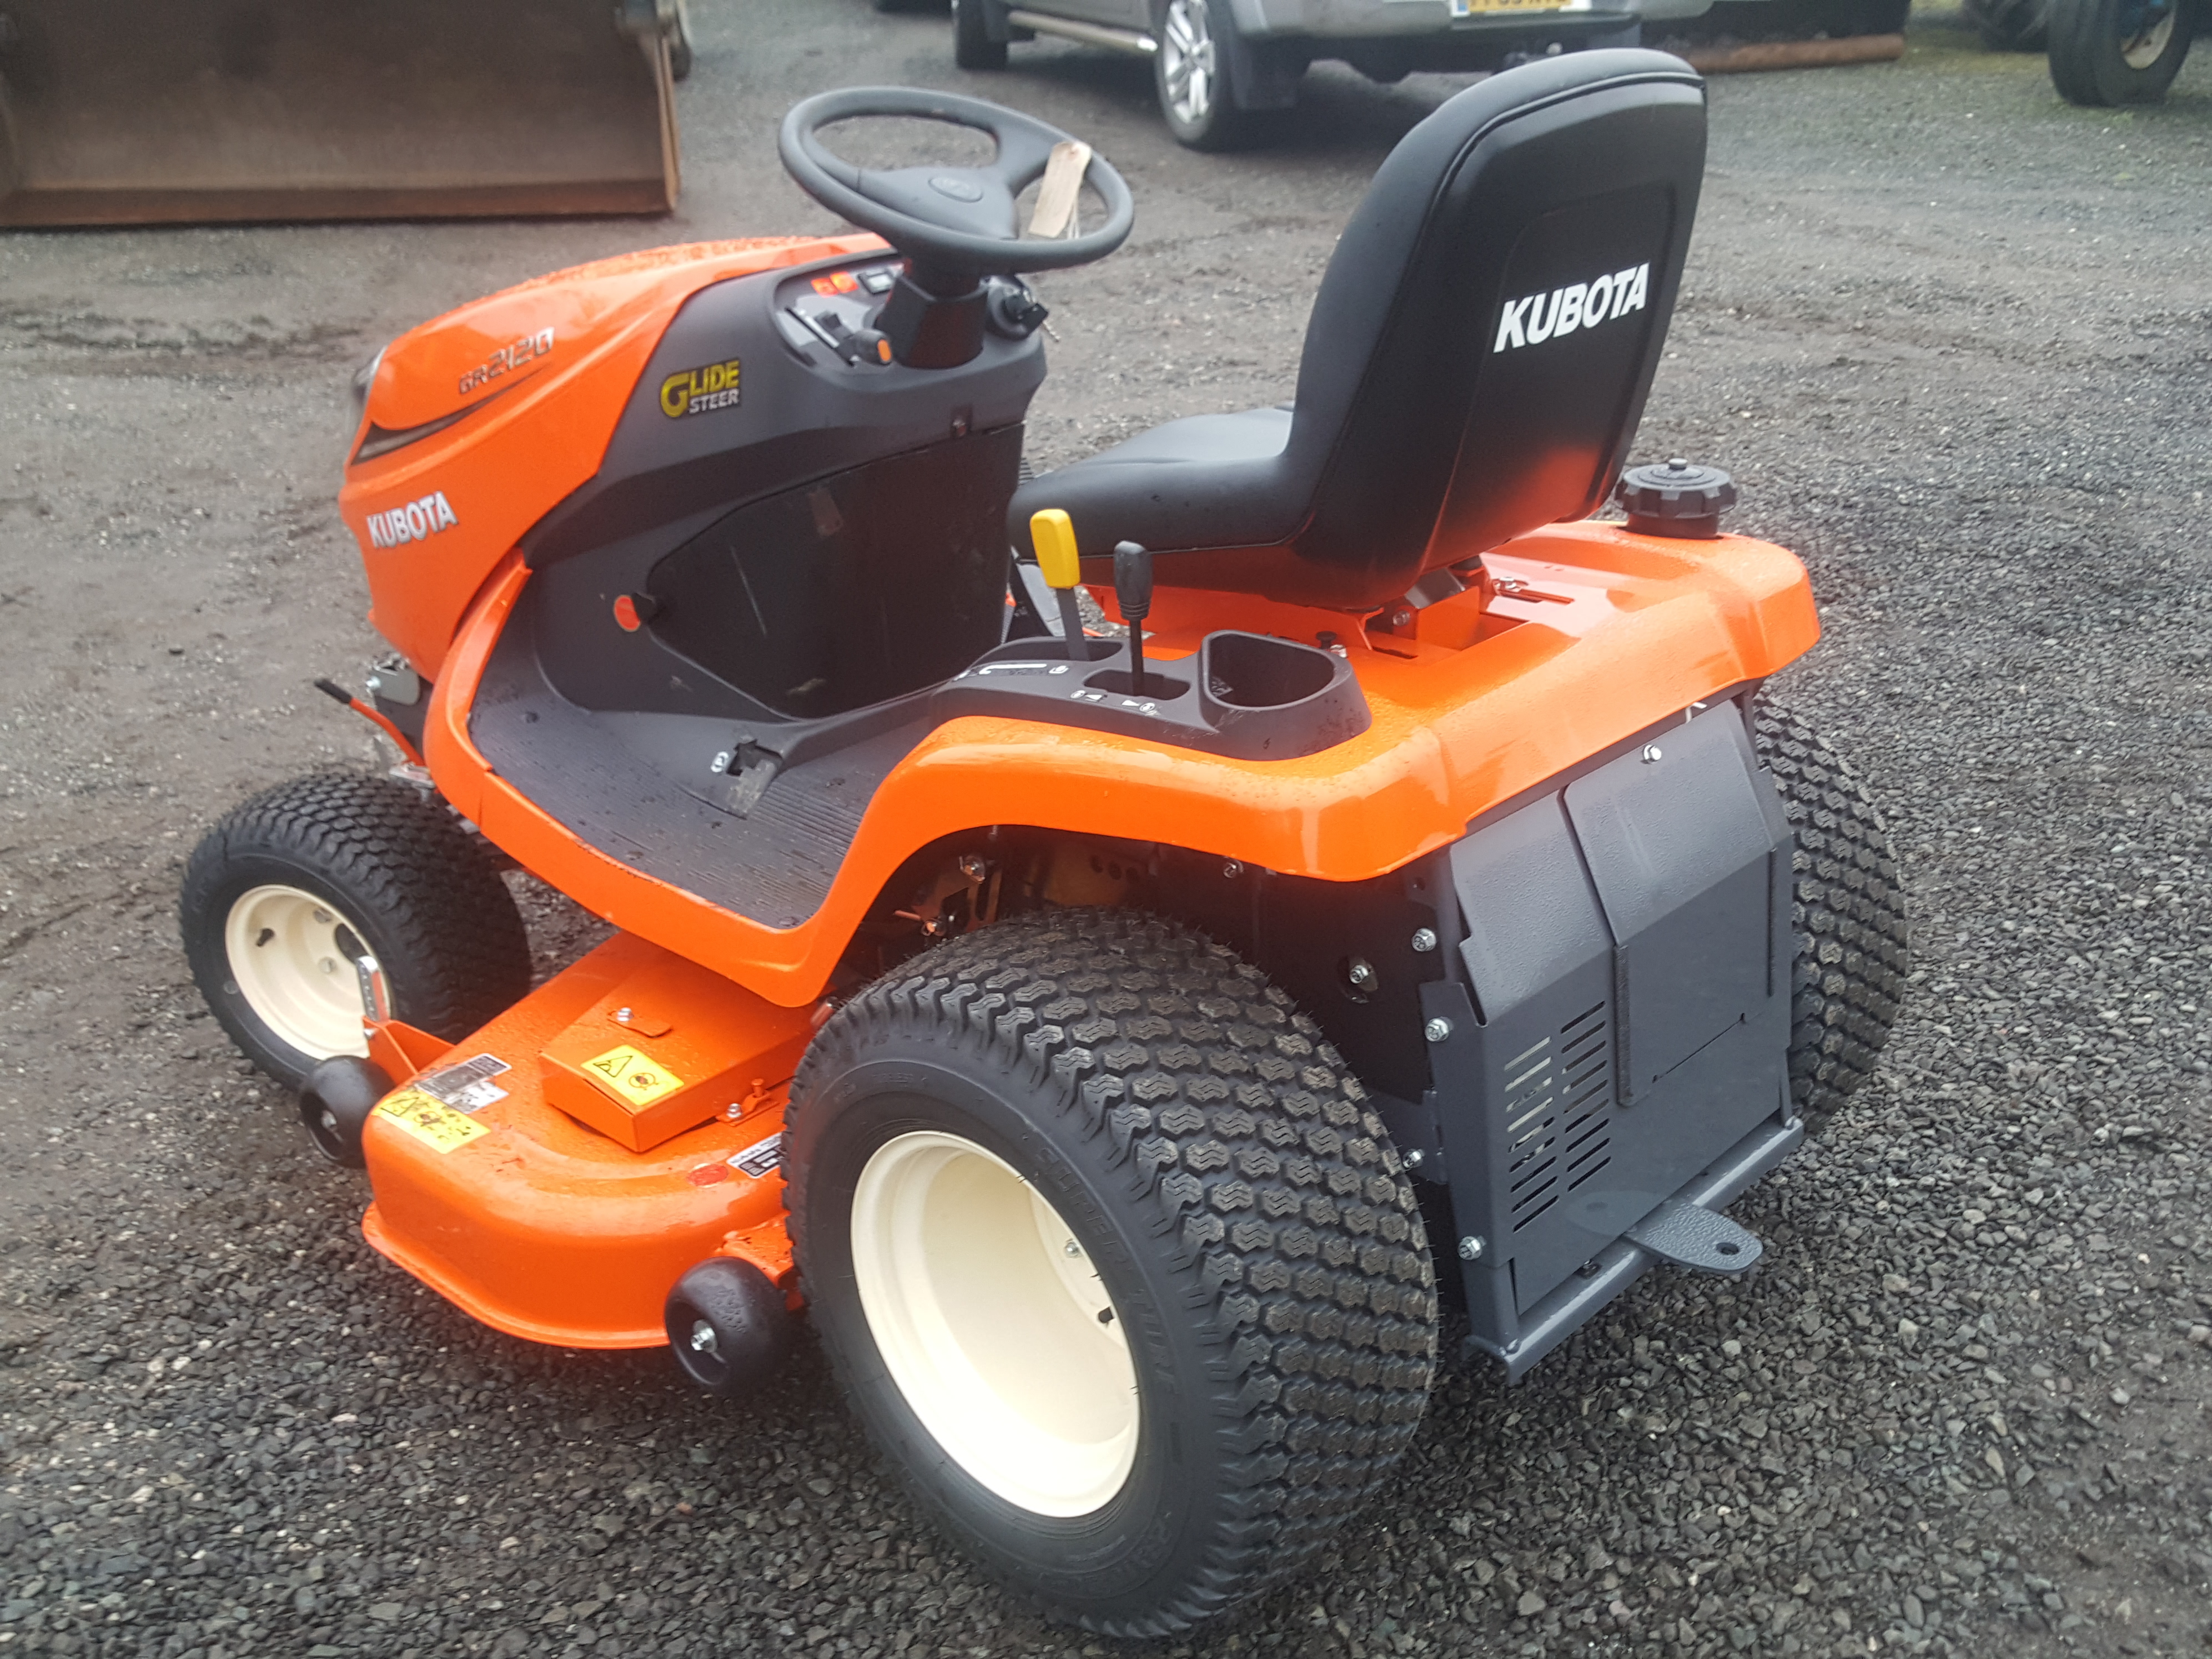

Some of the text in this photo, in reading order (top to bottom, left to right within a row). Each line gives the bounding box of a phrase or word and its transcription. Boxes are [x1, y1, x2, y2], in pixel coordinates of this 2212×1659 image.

[1493, 262, 1649, 353] KUBOTA
[661, 360, 740, 418] GLIDE
[688, 389, 739, 414] STEER
[366, 490, 459, 549] KUBOTA
[1036, 1147, 1180, 1395] SUPER TURF
